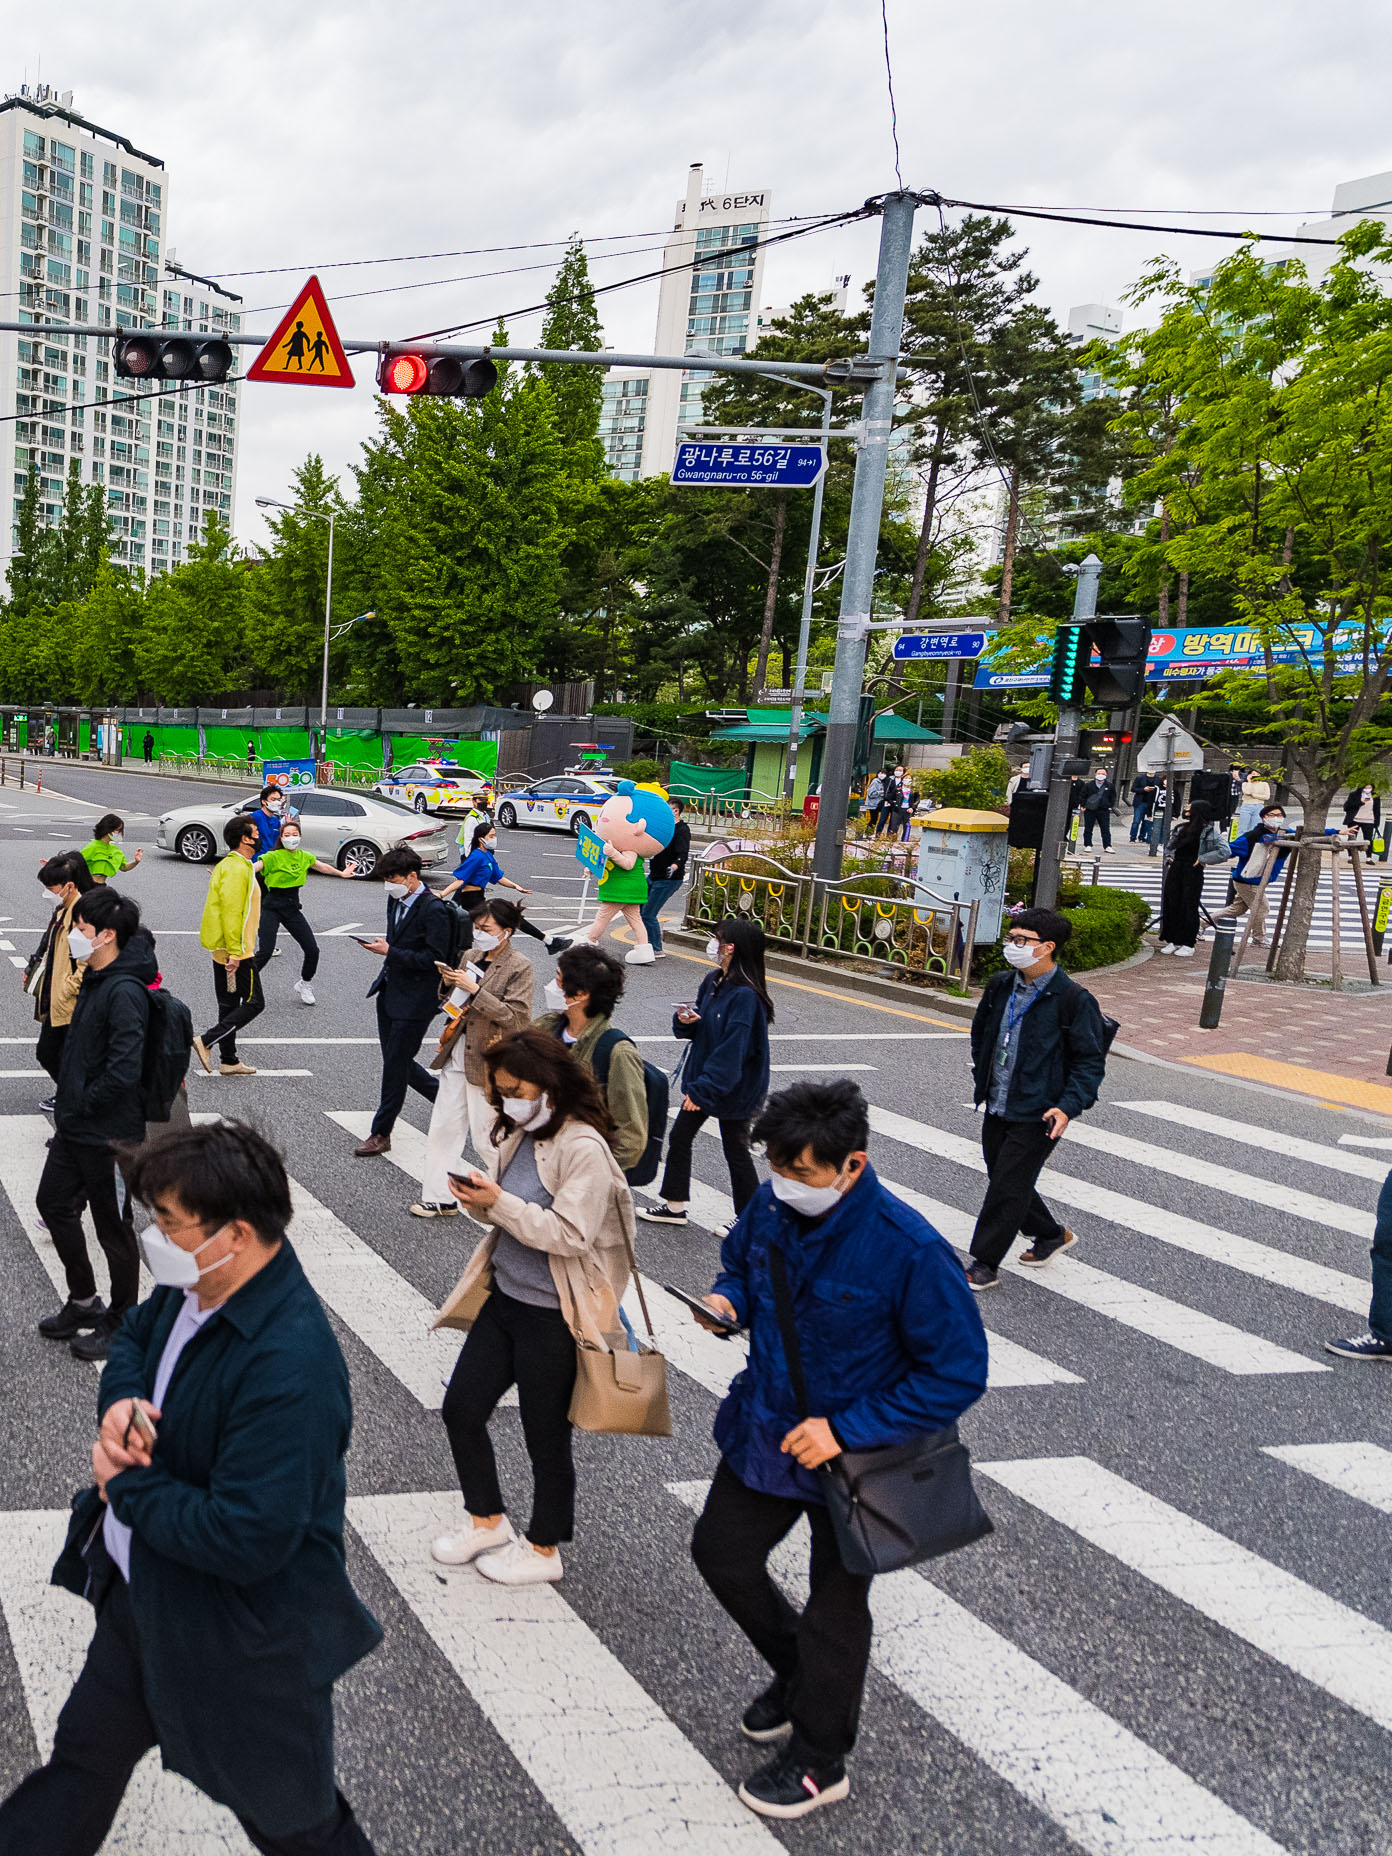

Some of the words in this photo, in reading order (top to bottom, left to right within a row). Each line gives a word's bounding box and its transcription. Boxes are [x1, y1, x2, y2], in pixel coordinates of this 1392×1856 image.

[723, 194, 764, 210] 6단지
[682, 447, 791, 469] 광나루로56길
[677, 469, 748, 481] Gwangnaru-ro
[750, 471, 779, 482] 56-gil
[920, 637, 958, 649] 강변역로
[266, 771, 313, 786] 5030
[582, 836, 600, 865] 광진
